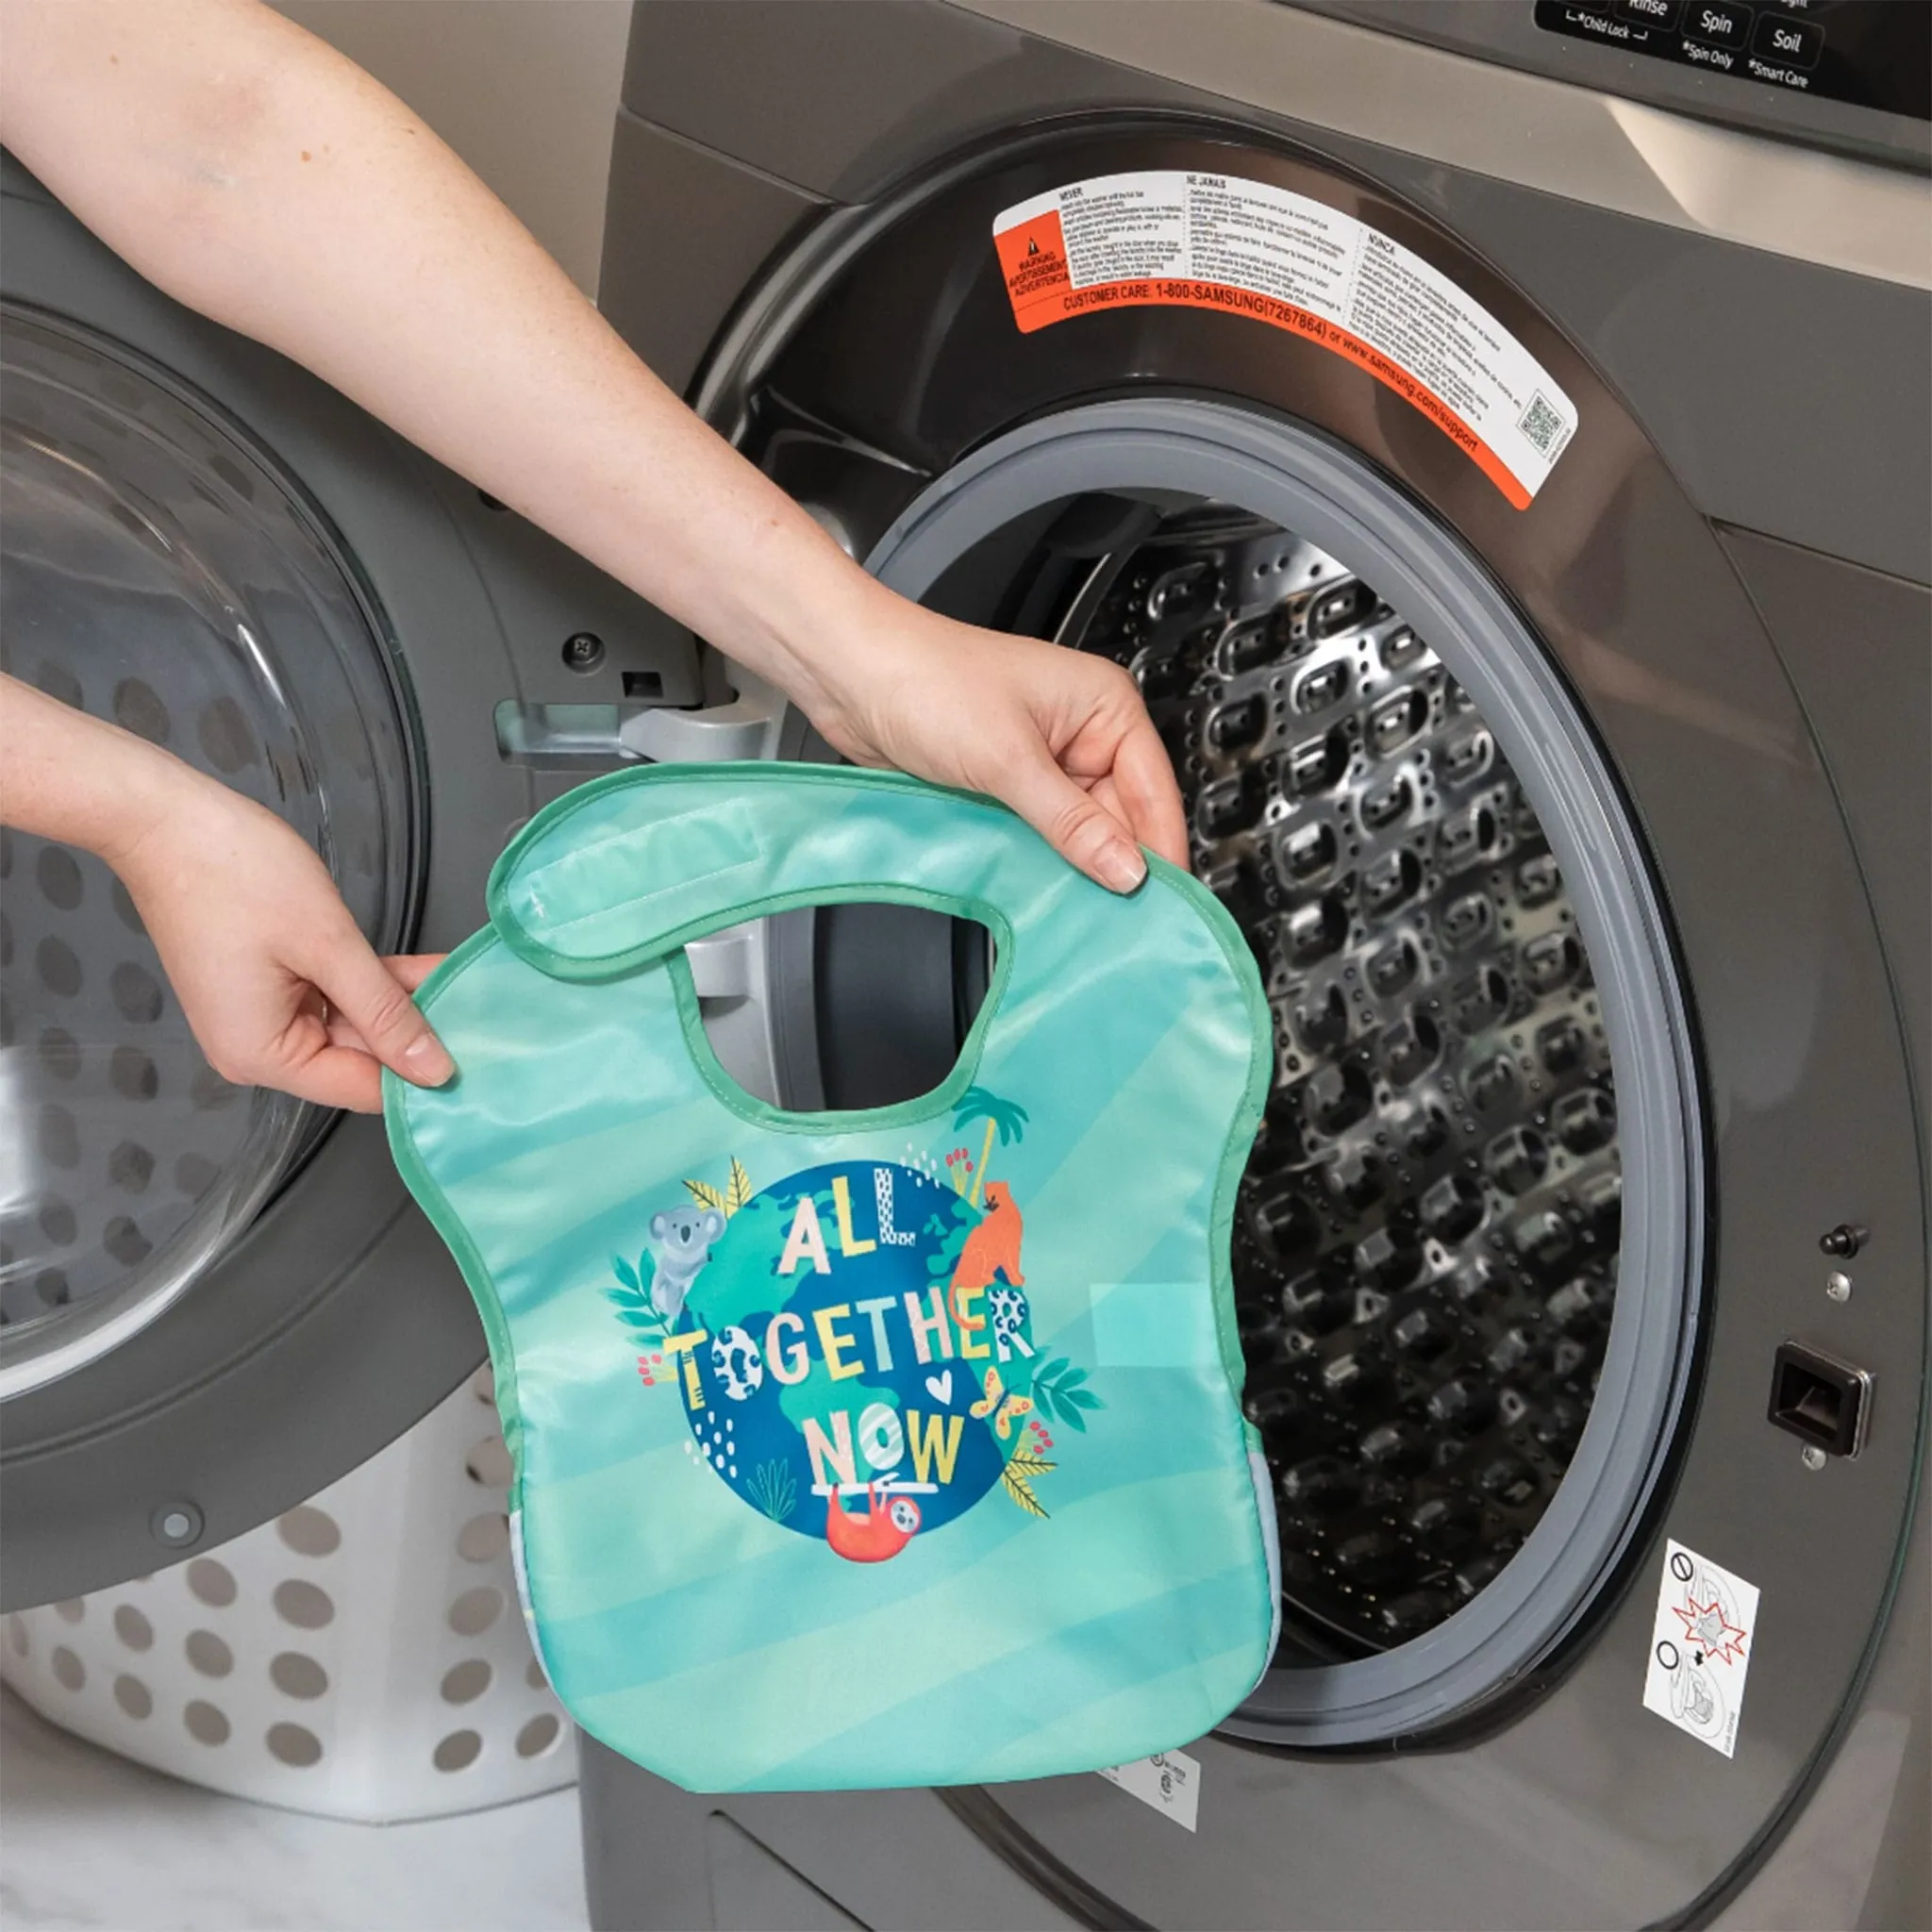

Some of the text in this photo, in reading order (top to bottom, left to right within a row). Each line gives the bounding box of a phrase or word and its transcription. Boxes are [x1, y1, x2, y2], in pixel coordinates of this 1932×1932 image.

[1607, 23, 1630, 39] Lock
[1700, 9, 1733, 34] Spin
[1773, 29, 1803, 53] Soil
[1710, 50, 1734, 70] Only
[1785, 71, 1809, 89] Care
[1063, 282, 1479, 453] CUSTOMER CARE: 1-800-SAMSUNG(7267864) or www.samsung.com/support
[777, 1167, 917, 1275] ALL
[663, 1285, 1036, 1411] TOGETHER
[802, 1401, 965, 1486] NOW
